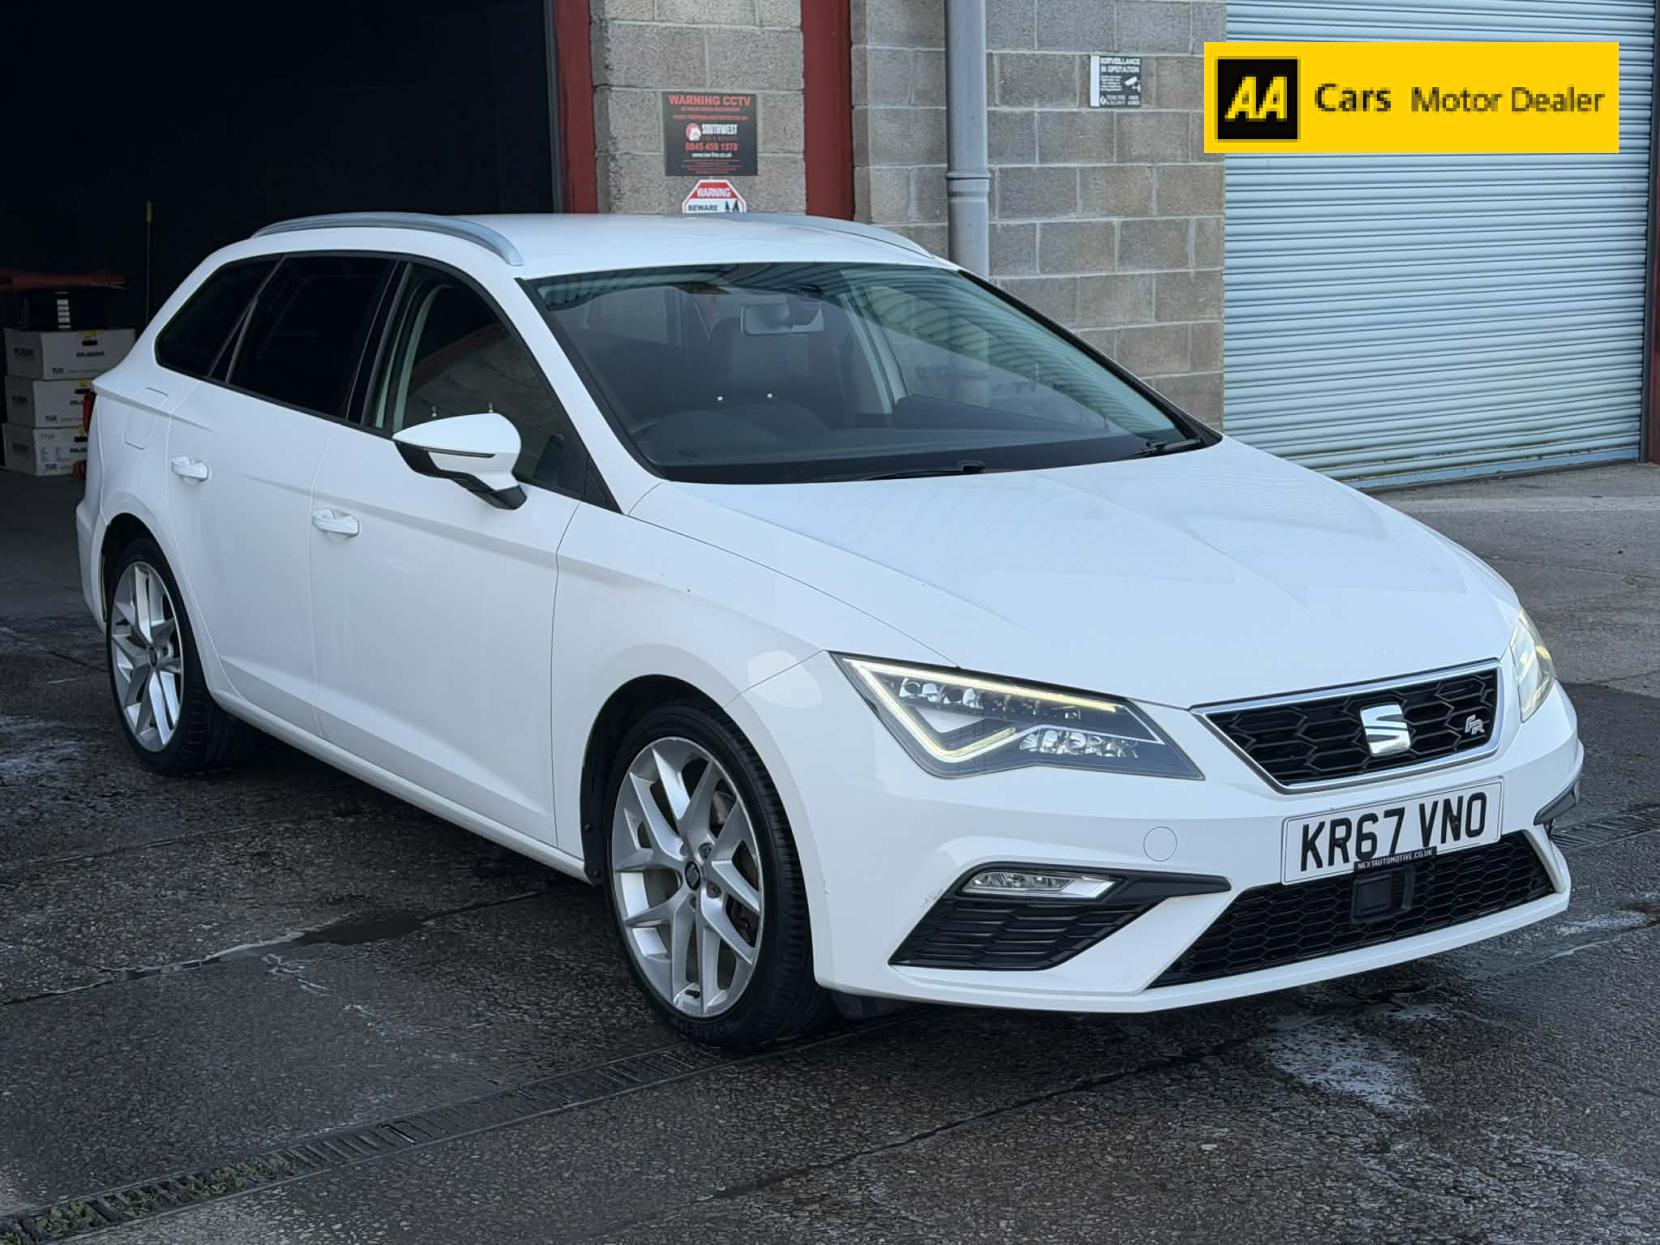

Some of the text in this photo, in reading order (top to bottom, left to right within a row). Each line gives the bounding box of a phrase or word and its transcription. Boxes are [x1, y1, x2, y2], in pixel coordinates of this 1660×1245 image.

[668, 95, 752, 107] WARNING CCTV
[697, 187, 731, 198] WARNING
[1300, 791, 1488, 872] KR67 VNO
